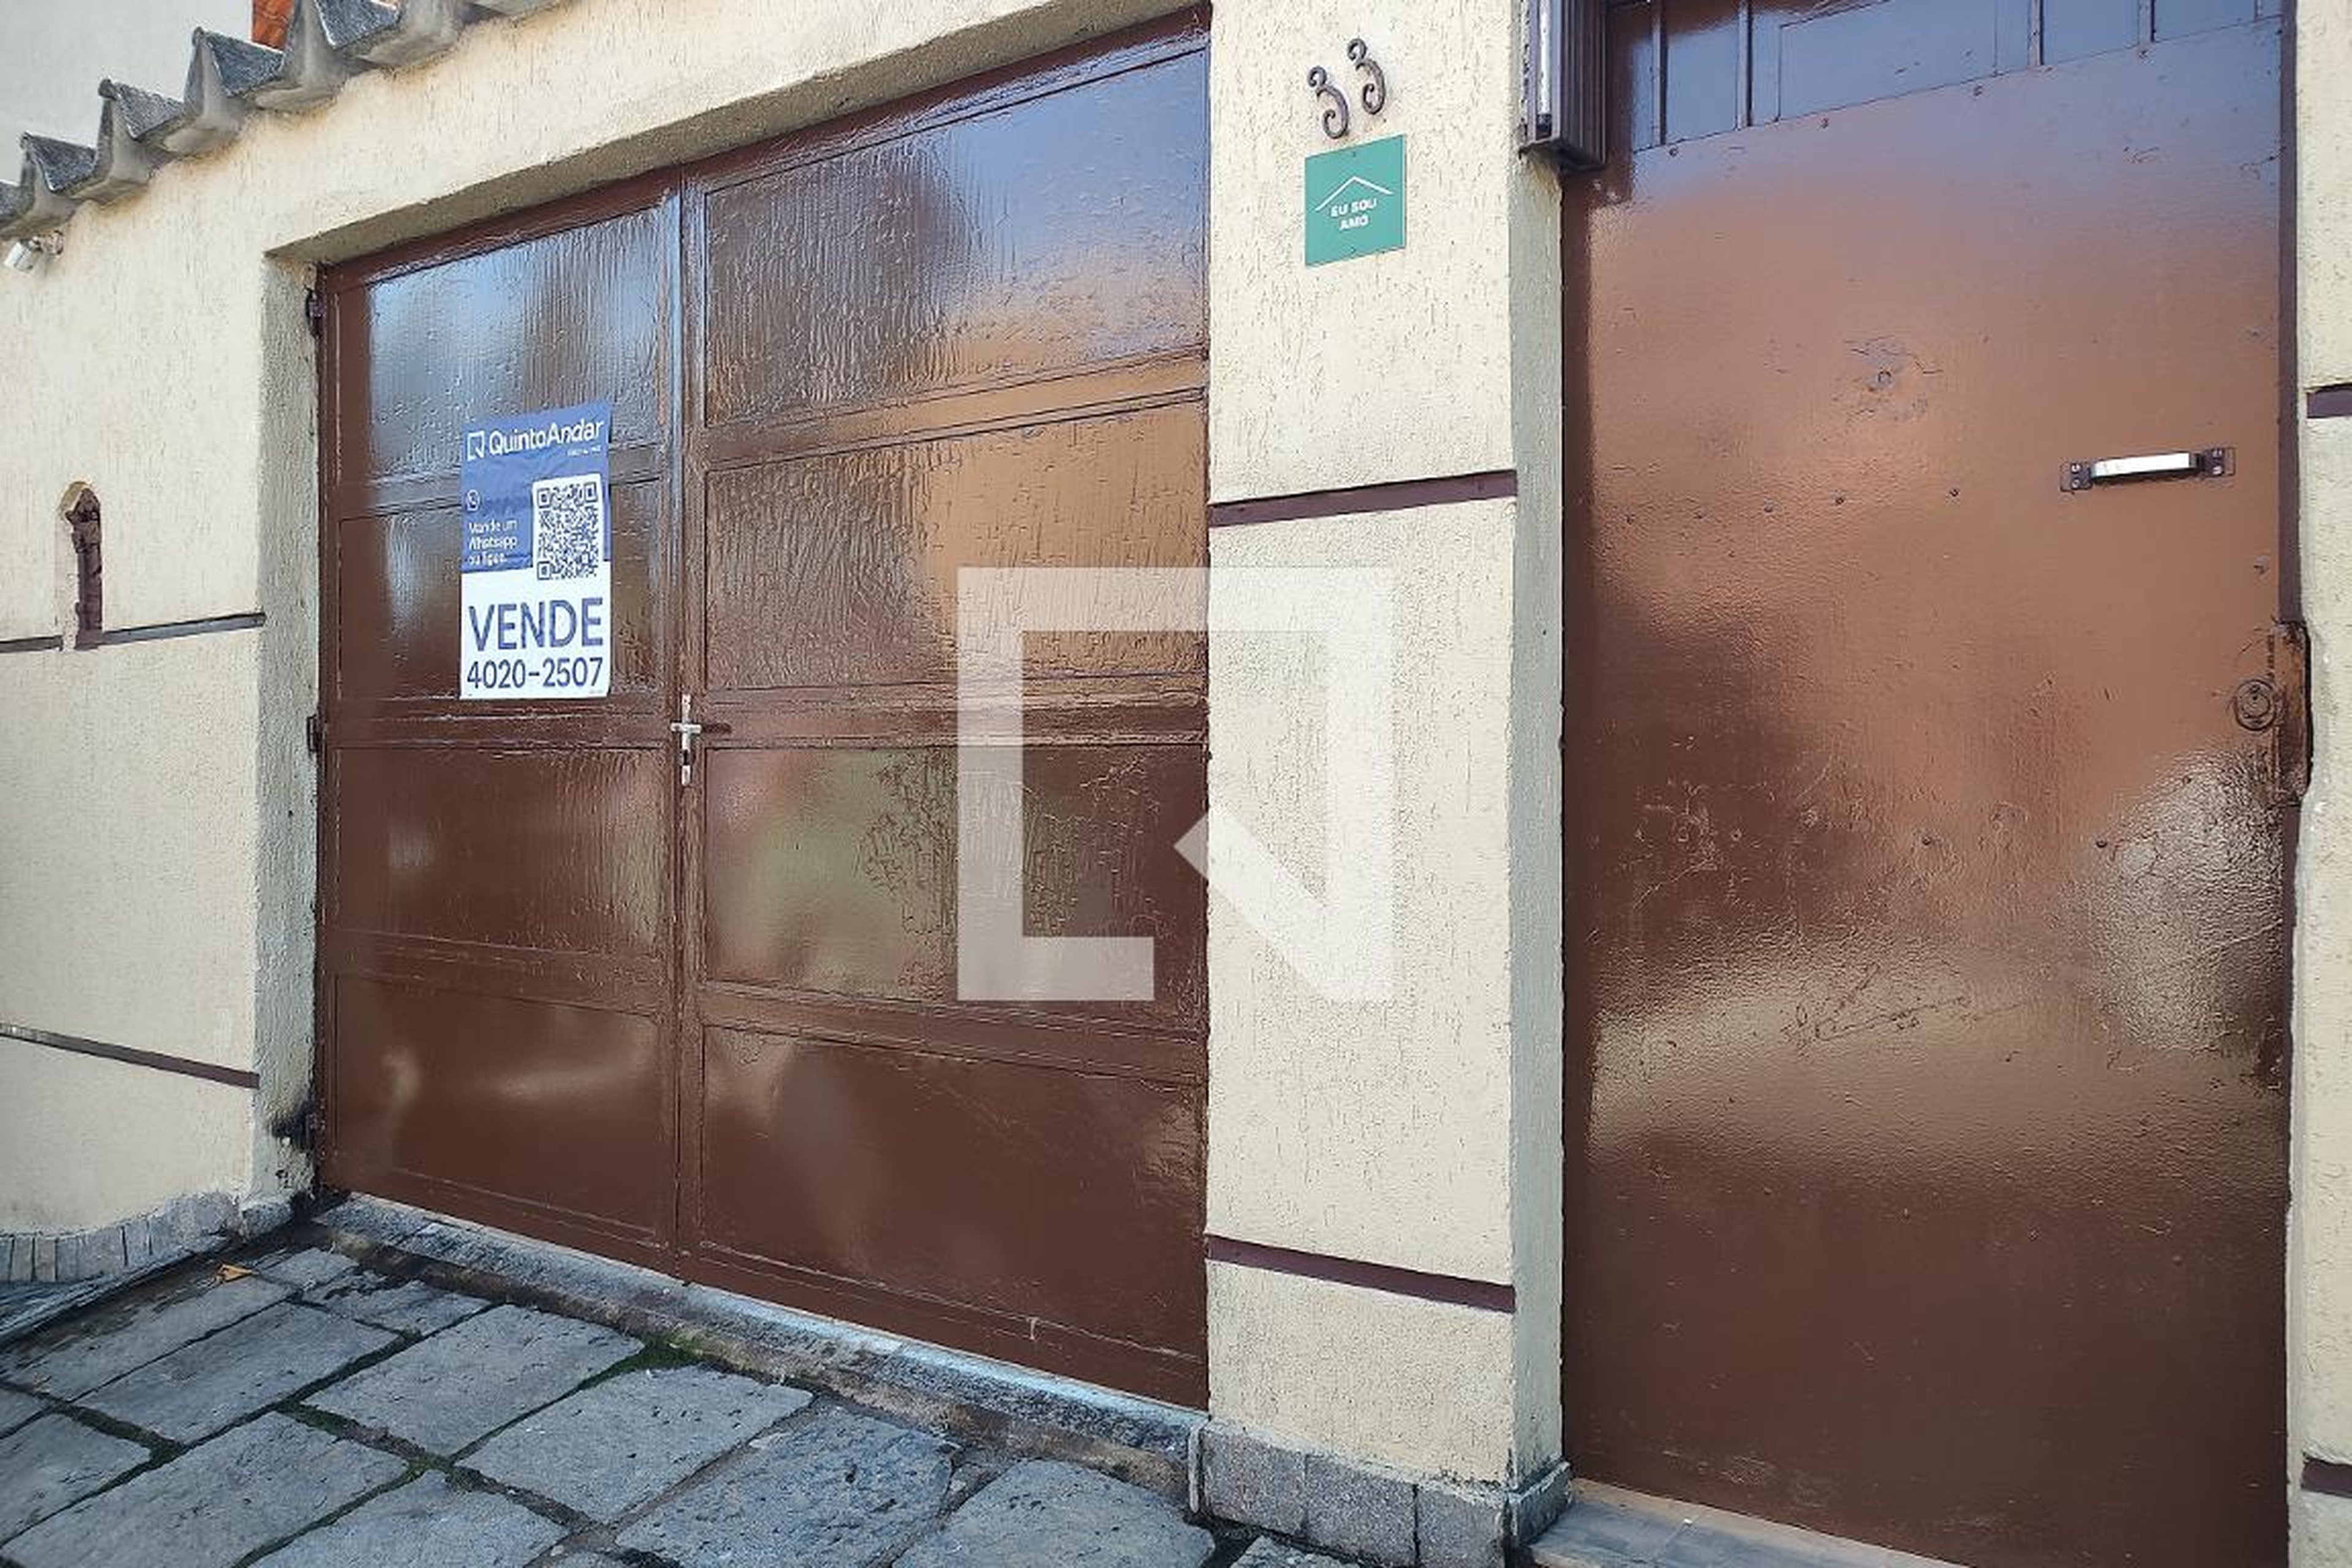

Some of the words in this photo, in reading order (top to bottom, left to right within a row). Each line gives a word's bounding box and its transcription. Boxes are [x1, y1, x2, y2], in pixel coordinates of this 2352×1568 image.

[1307, 38, 1386, 139] 33
[1331, 203, 1348, 217] EU
[1351, 198, 1377, 214] SOU
[489, 419, 604, 456] QuintoAndar
[469, 597, 603, 652] VENDE
[467, 657, 603, 689] 4020-2507
